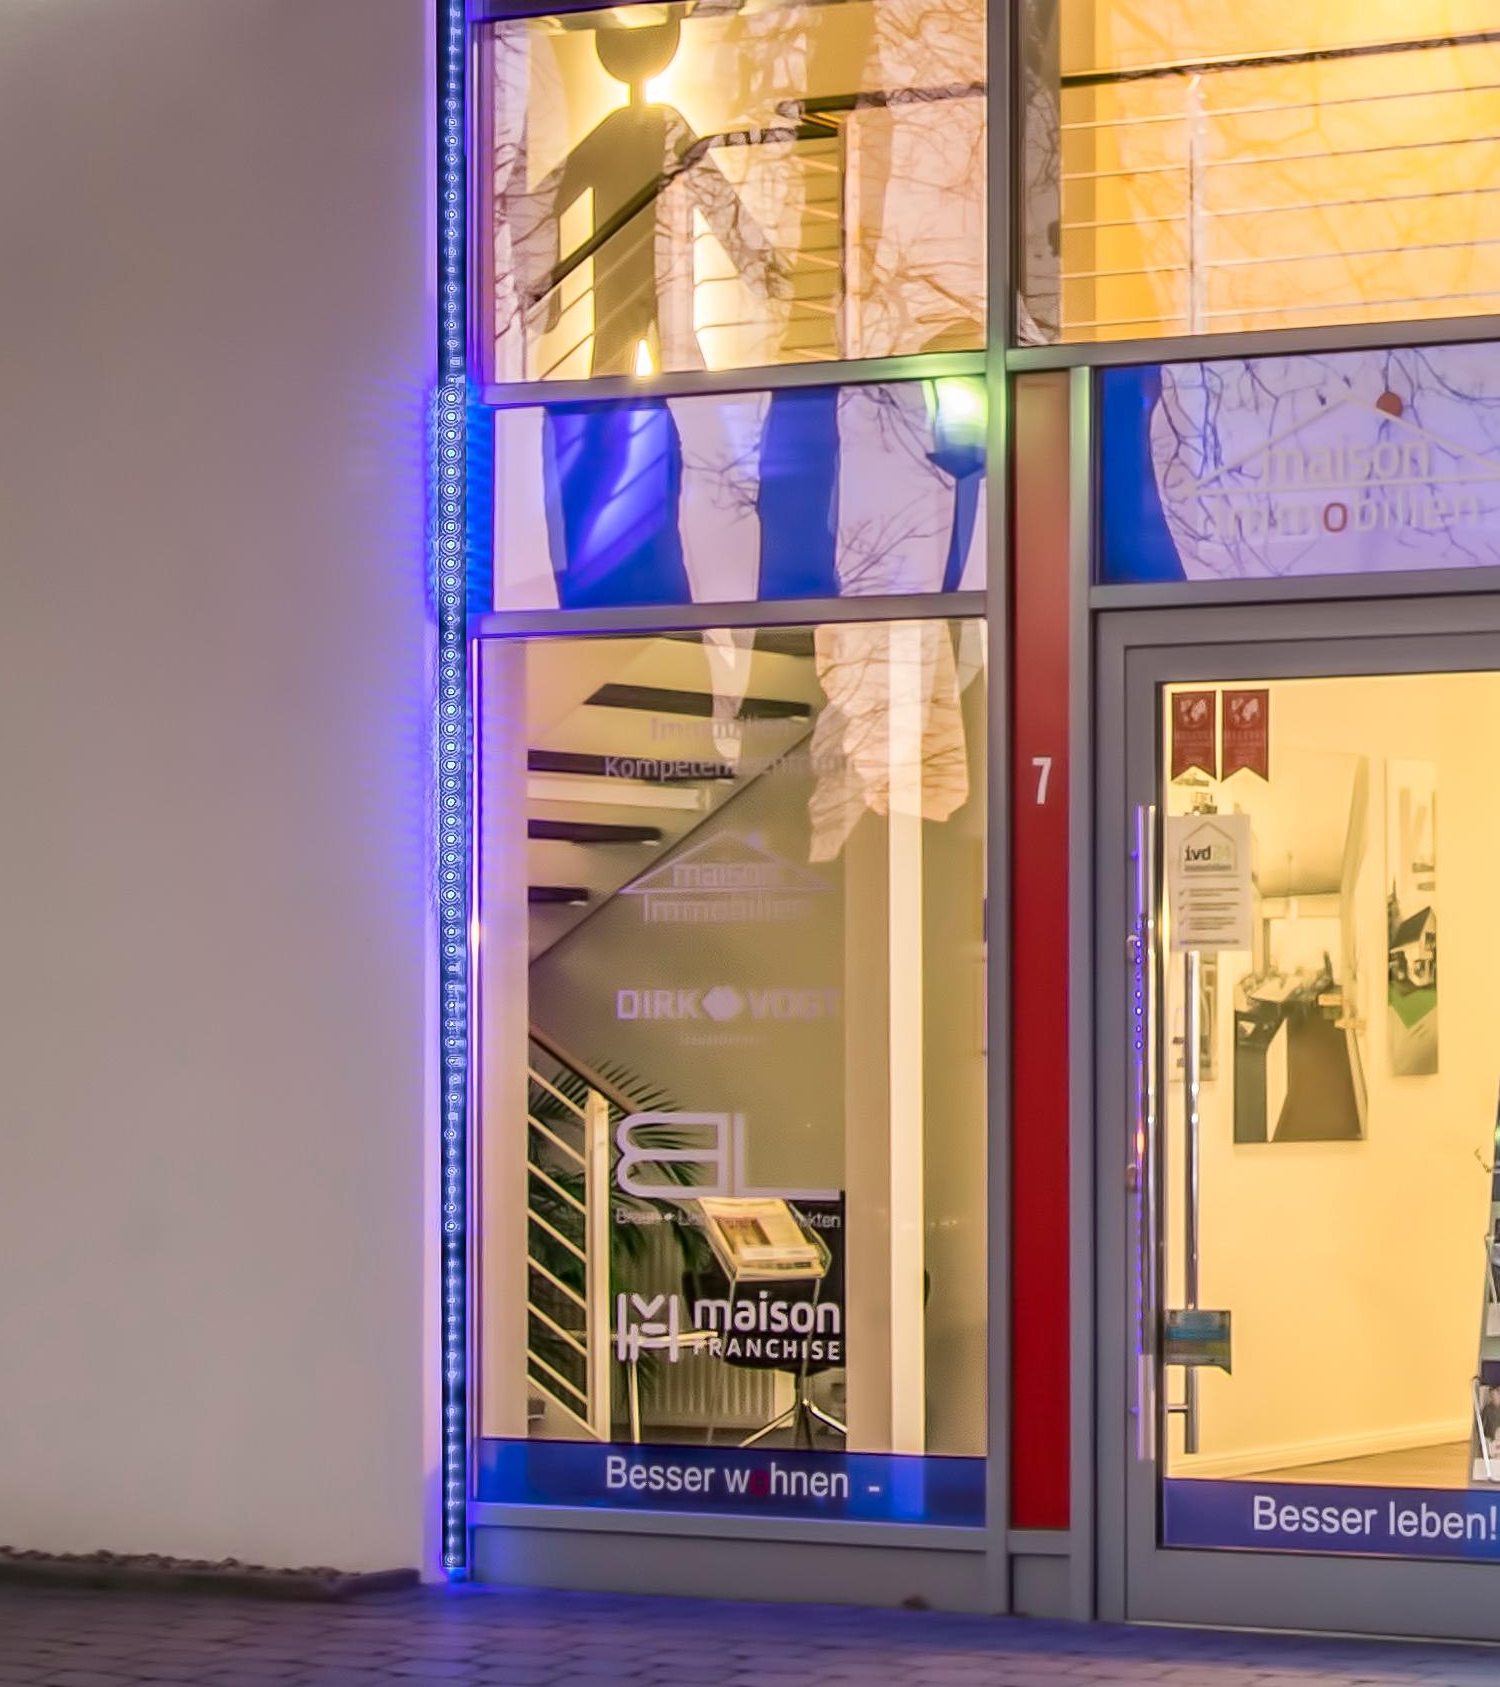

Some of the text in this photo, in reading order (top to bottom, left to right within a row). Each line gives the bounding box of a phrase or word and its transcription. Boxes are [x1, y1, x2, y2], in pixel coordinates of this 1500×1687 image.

[1263, 436, 1430, 482] maison
[1032, 756, 1053, 805] 7
[615, 989, 700, 1019] DIRK
[693, 1290, 841, 1335] maison
[692, 1336, 841, 1361] FRANCHISE
[606, 1455, 716, 1492] Besser
[725, 1462, 848, 1498] wohnen
[1253, 1495, 1498, 1541] Besser leben!
